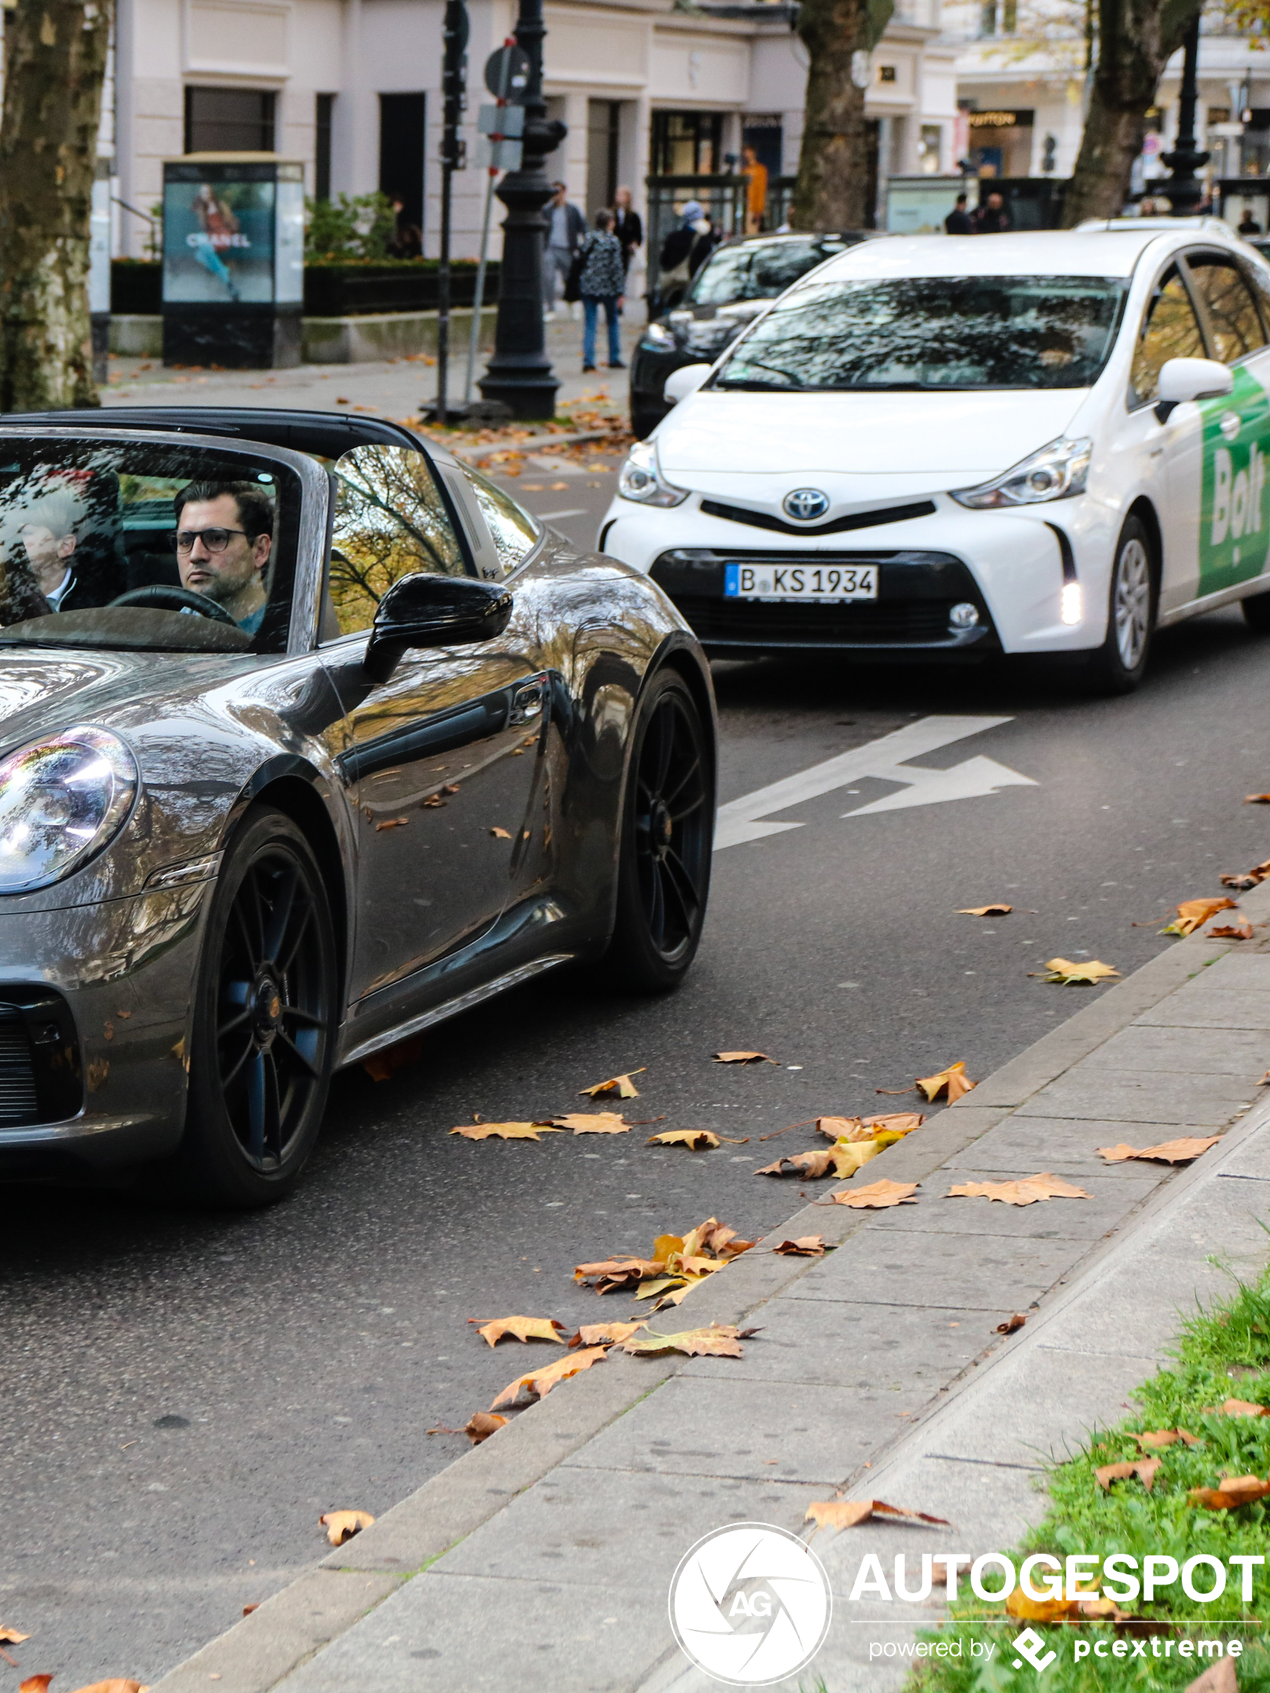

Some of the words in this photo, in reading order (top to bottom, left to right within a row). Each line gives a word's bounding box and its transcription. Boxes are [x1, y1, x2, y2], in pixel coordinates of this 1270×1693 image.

[1210, 441, 1265, 567] Bolt
[741, 569, 755, 592] B
[774, 569, 806, 593] KS
[811, 570, 873, 594] 1934
